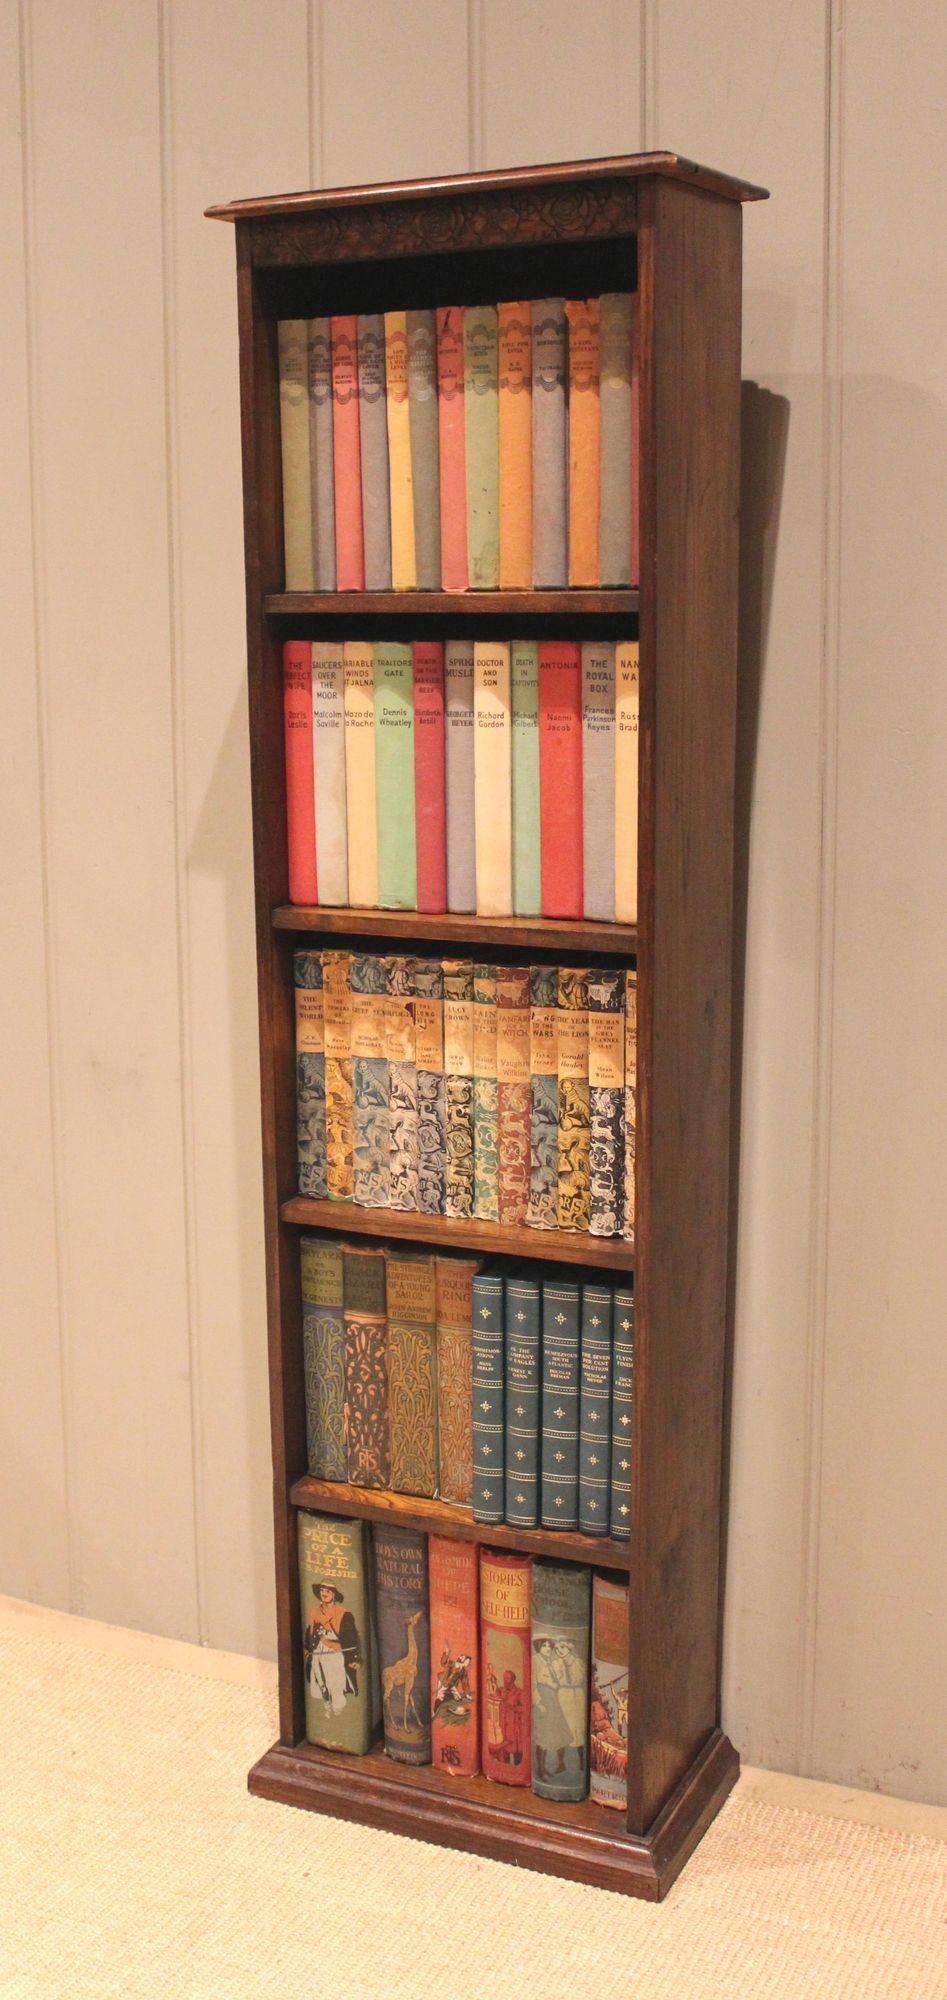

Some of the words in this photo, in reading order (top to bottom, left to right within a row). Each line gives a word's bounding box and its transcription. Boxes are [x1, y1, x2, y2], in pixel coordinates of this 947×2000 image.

[288, 662, 304, 670] THE
[312, 660, 343, 670] SAUCERS
[377, 659, 412, 667] TRAITORS
[449, 658, 474, 667] SPRIG
[476, 659, 504, 667] DOCTOR
[540, 661, 578, 669] ANTONIA
[590, 659, 608, 668] THE
[317, 671, 337, 680] OVER
[345, 670, 369, 678] WINDS
[384, 670, 405, 678] GATE
[445, 669, 474, 678] MUSLI
[482, 669, 498, 677] AND
[521, 669, 528, 677] IN
[586, 671, 615, 681] ROYAL
[320, 682, 335, 690] THE
[351, 679, 374, 687] JALNA
[482, 679, 498, 687] SON
[590, 684, 609, 693] BOX
[317, 691, 339, 700] MOOR
[314, 710, 342, 719] Malcolm
[364, 710, 374, 719] de
[382, 707, 407, 717] Dennis
[584, 705, 615, 715] Frances
[287, 711, 307, 720] Doris
[477, 711, 505, 720] Richard
[547, 713, 572, 721] Naomi
[583, 713, 616, 723] Parkinson
[316, 720, 341, 728] Saville
[351, 719, 374, 728] Roche
[379, 717, 412, 729] Wheatley
[478, 720, 505, 729] Gordon
[587, 722, 611, 733] Keyes
[546, 724, 572, 732] Jacob
[502, 1029, 529, 1037] WITCH
[533, 1030, 554, 1038] WARS
[442, 1289, 472, 1303] RING
[311, 1543, 327, 1553] OF
[331, 1546, 345, 1556] A
[400, 1548, 423, 1560] OWN
[305, 1550, 350, 1570] LIFE
[376, 1556, 423, 1575] NATURAL
[377, 1571, 424, 1590] HISTORY
[483, 1569, 523, 1588] STORIES
[495, 1589, 510, 1602] OF
